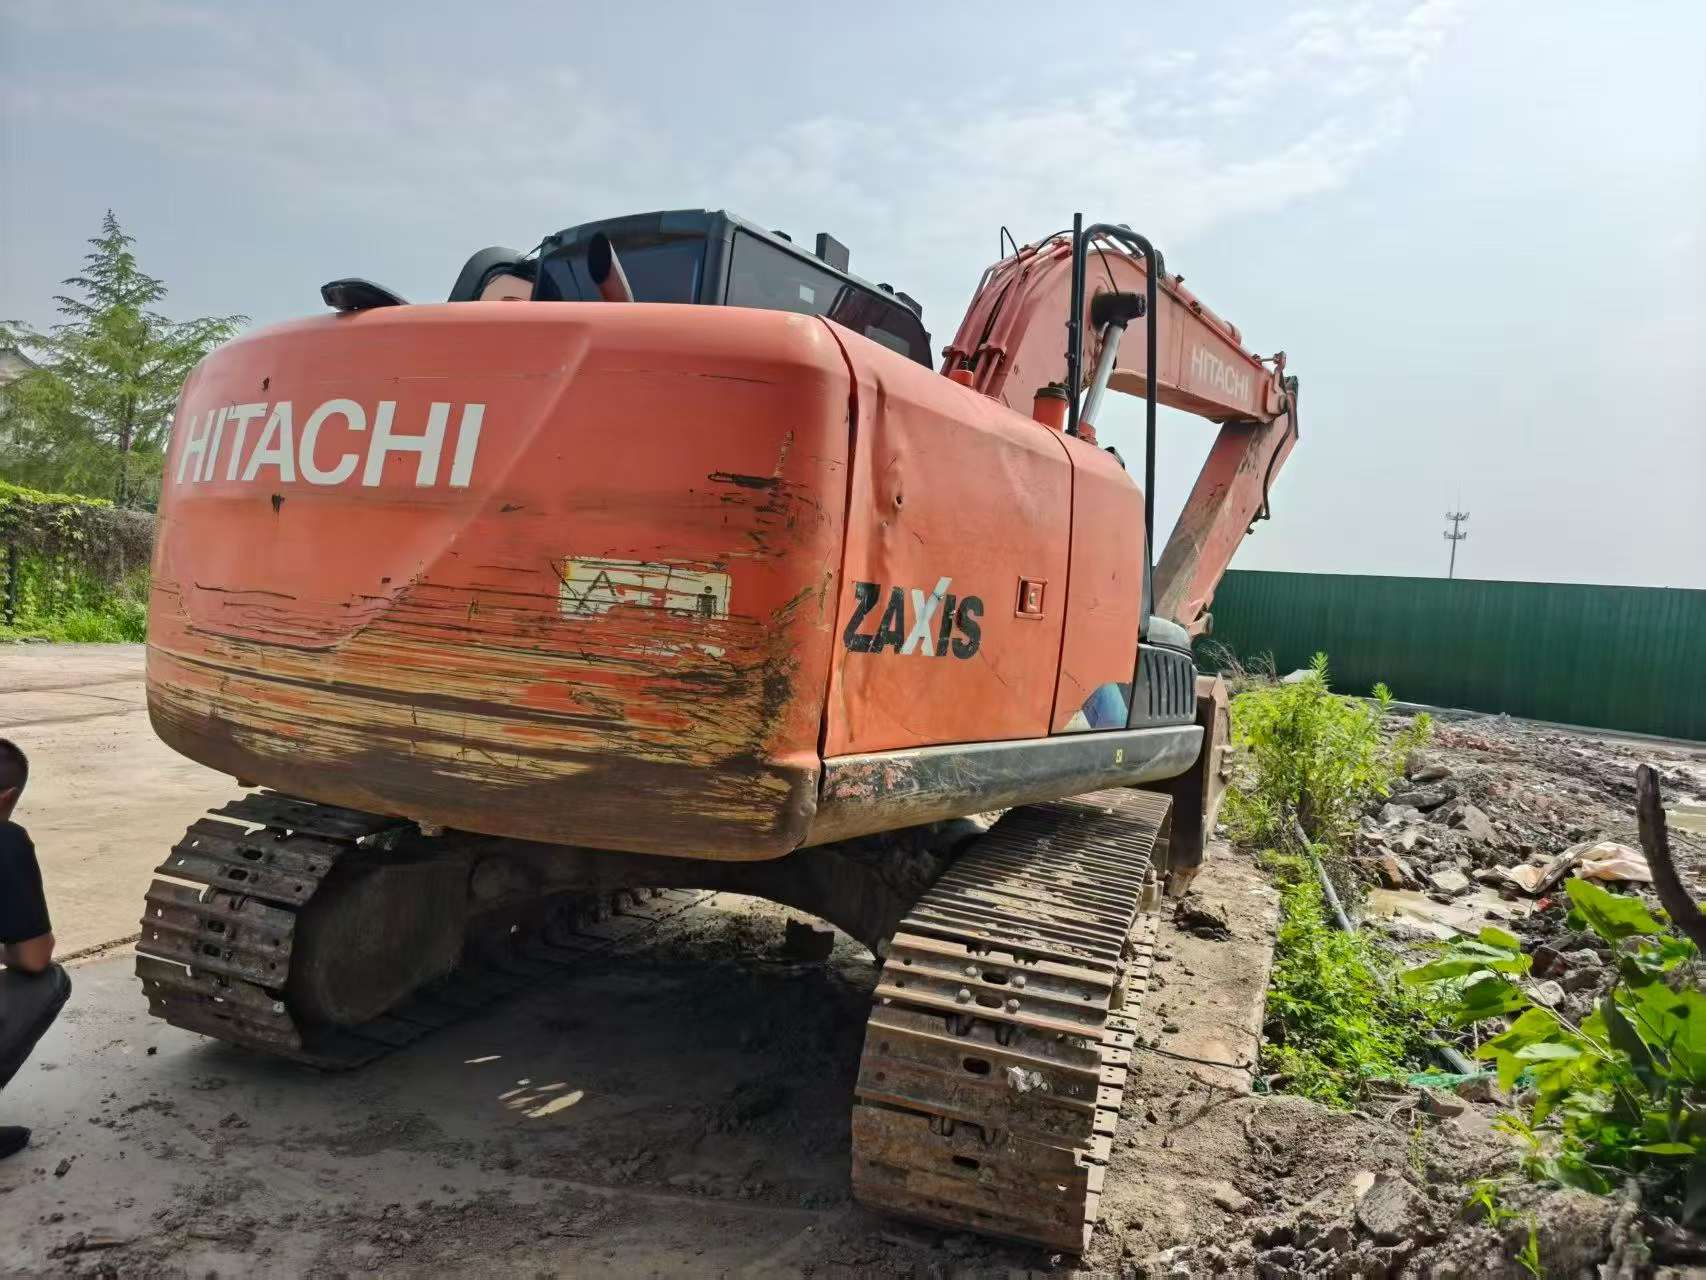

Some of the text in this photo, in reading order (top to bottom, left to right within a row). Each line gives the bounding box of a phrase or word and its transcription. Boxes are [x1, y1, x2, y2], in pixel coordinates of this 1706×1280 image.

[1190, 343, 1250, 403] HITACHI
[175, 398, 487, 488] HITACHI
[843, 576, 984, 660] ZAXIS
